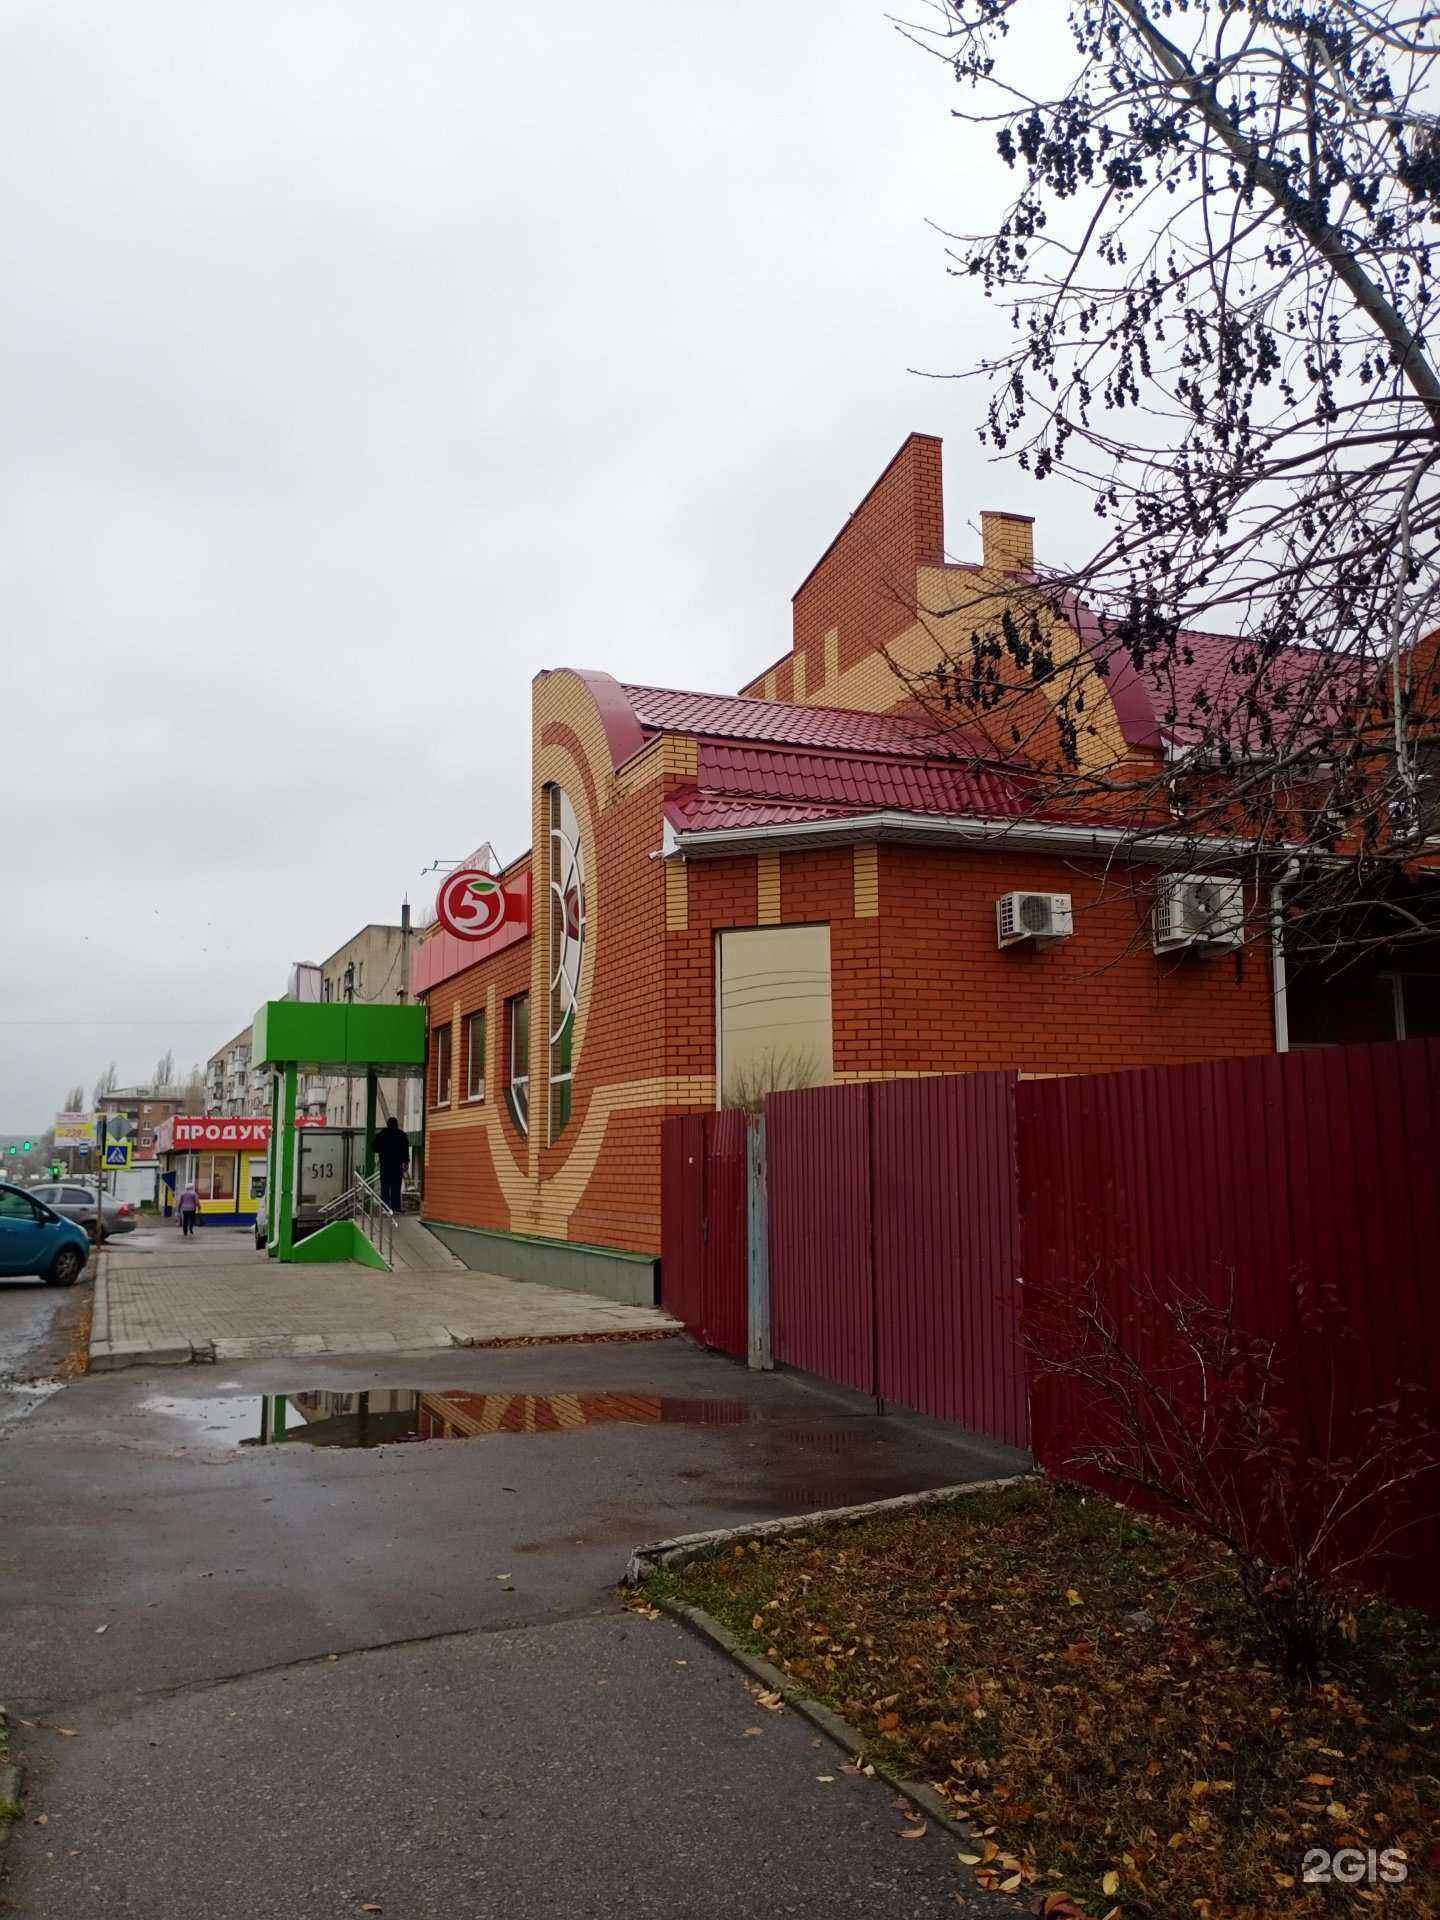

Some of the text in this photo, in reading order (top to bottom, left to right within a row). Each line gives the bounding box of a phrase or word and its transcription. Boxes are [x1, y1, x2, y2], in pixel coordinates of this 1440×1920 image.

[451, 881, 497, 928] 5
[175, 1124, 272, 1141] ПРОДУК
[311, 1163, 334, 1180] 513
